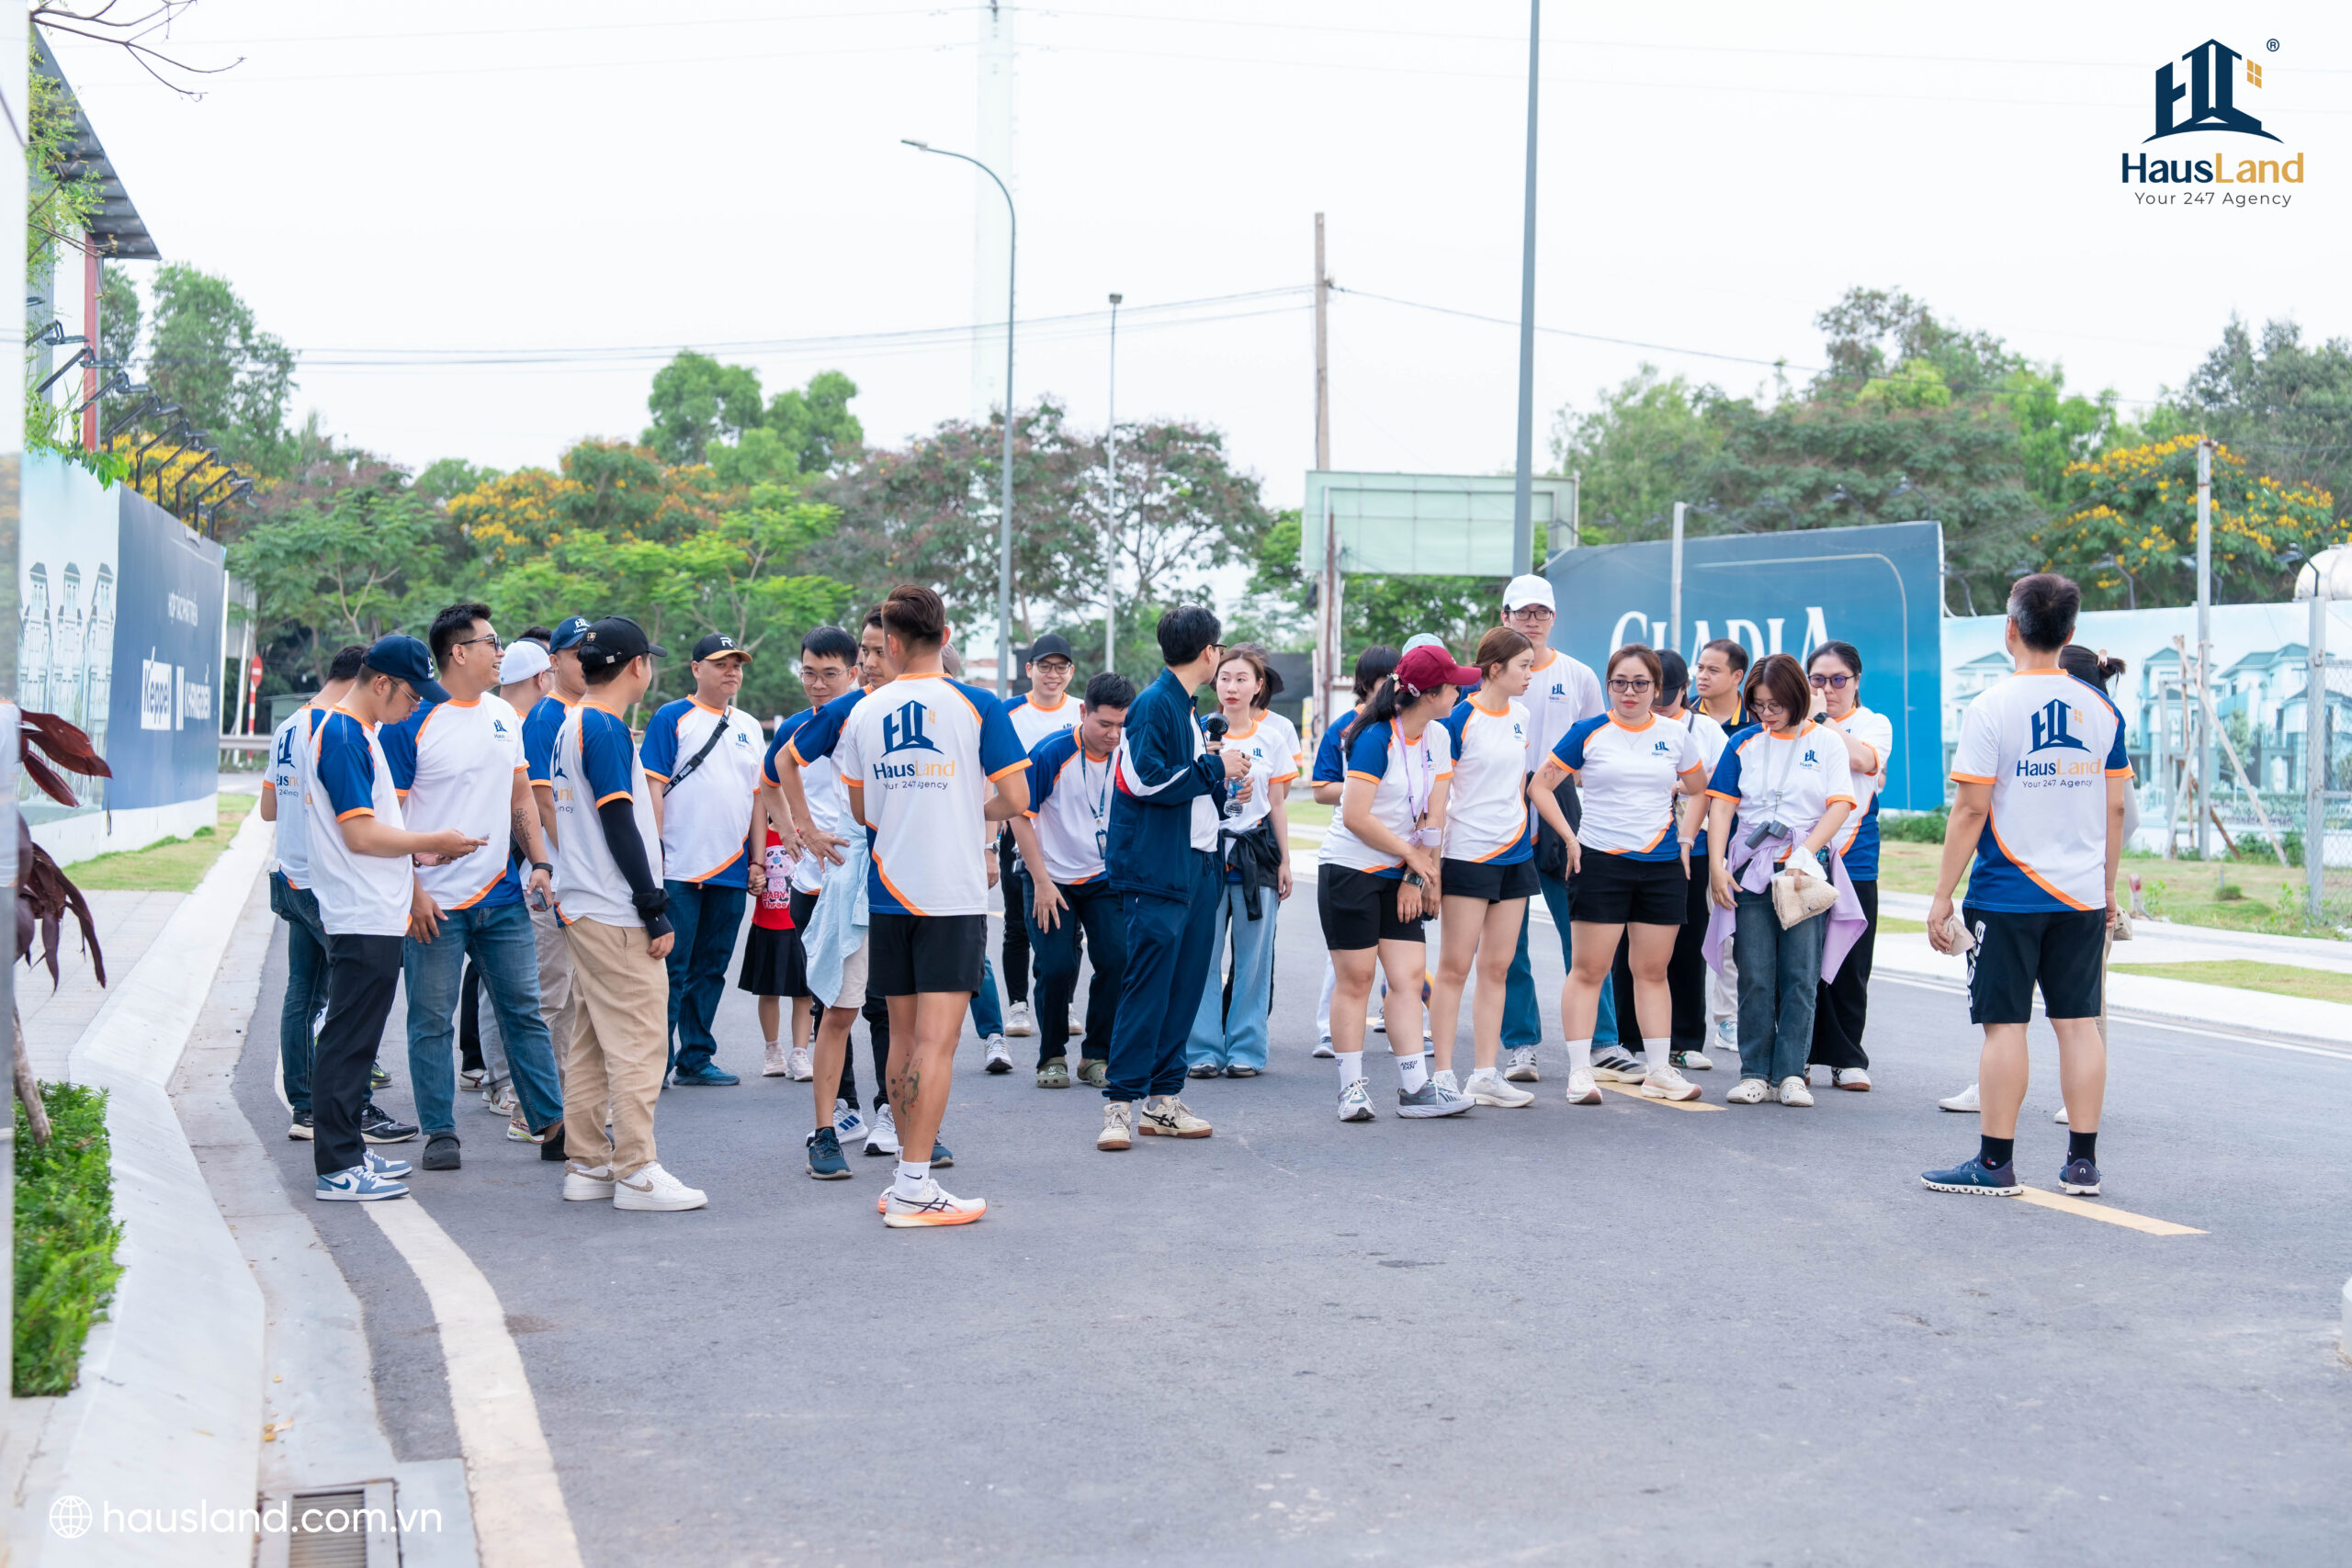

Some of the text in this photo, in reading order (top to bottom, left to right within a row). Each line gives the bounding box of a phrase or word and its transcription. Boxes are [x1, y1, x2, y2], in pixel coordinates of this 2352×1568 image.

[143, 661, 170, 725] Keppel
[873, 760, 956, 780] HausLand
[2016, 758, 2102, 777] HausLand
[2022, 780, 2041, 788] Your
[2043, 779, 2057, 787] 247
[763, 891, 786, 899] BABY
[763, 901, 787, 909] Three
